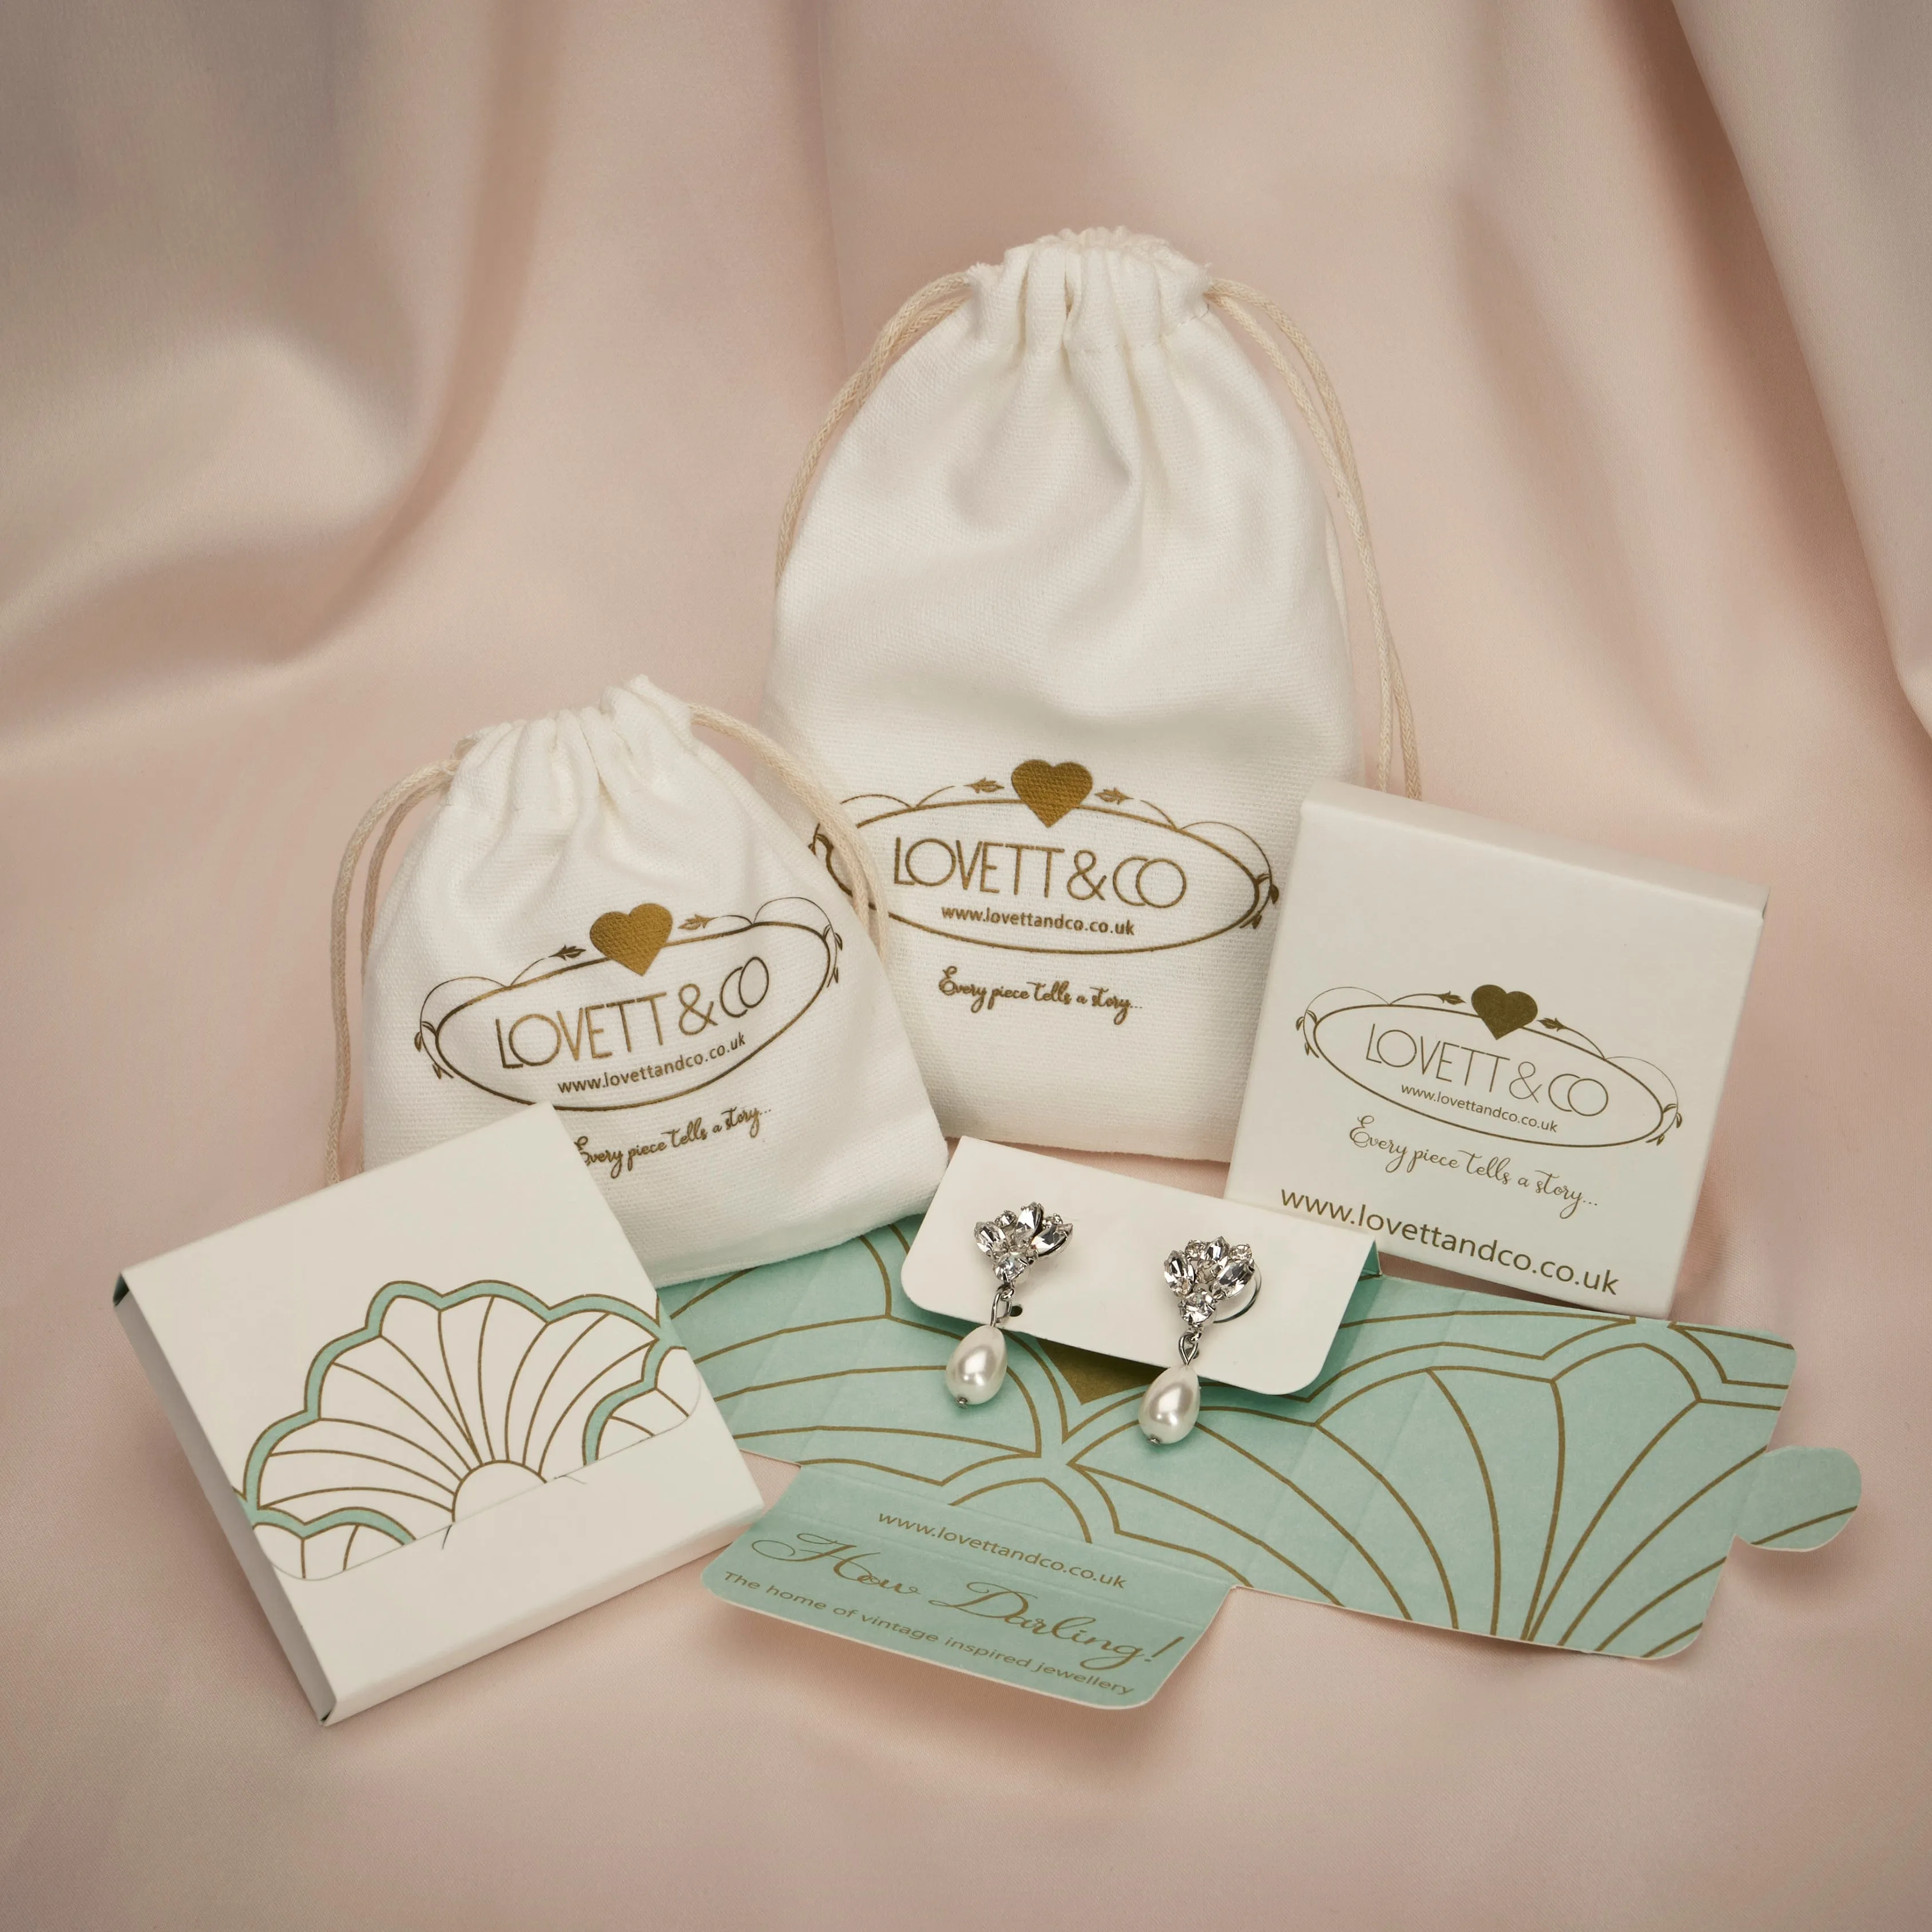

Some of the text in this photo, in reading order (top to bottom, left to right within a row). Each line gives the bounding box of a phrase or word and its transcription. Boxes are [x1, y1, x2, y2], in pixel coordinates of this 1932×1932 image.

[941, 903, 1135, 937] www.lovettandco.co.uk
[938, 965, 986, 1013] Every
[986, 982, 1030, 1009] piece
[1028, 980, 1072, 1006] tells
[1077, 994, 1088, 1005] a
[557, 1032, 746, 1094] www.lovettandco.co.uk
[1401, 1083, 1558, 1133] www.lovettandco.co.uk
[627, 1141, 667, 1172] piece
[661, 1117, 708, 1148] tells
[712, 1125, 722, 1134] a
[1349, 1114, 1409, 1173] Every
[1407, 1148, 1459, 1173] piece
[1458, 1149, 1512, 1185] tells
[1517, 1176, 1529, 1188] a
[1280, 1188, 1620, 1295] www.lovettandco.co.uk
[878, 1510, 1127, 1589] www.lovettandco.co.uk
[724, 1572, 1136, 1696] The home of vintage inspired jewellery
[750, 1532, 1184, 1671] How Darling!
